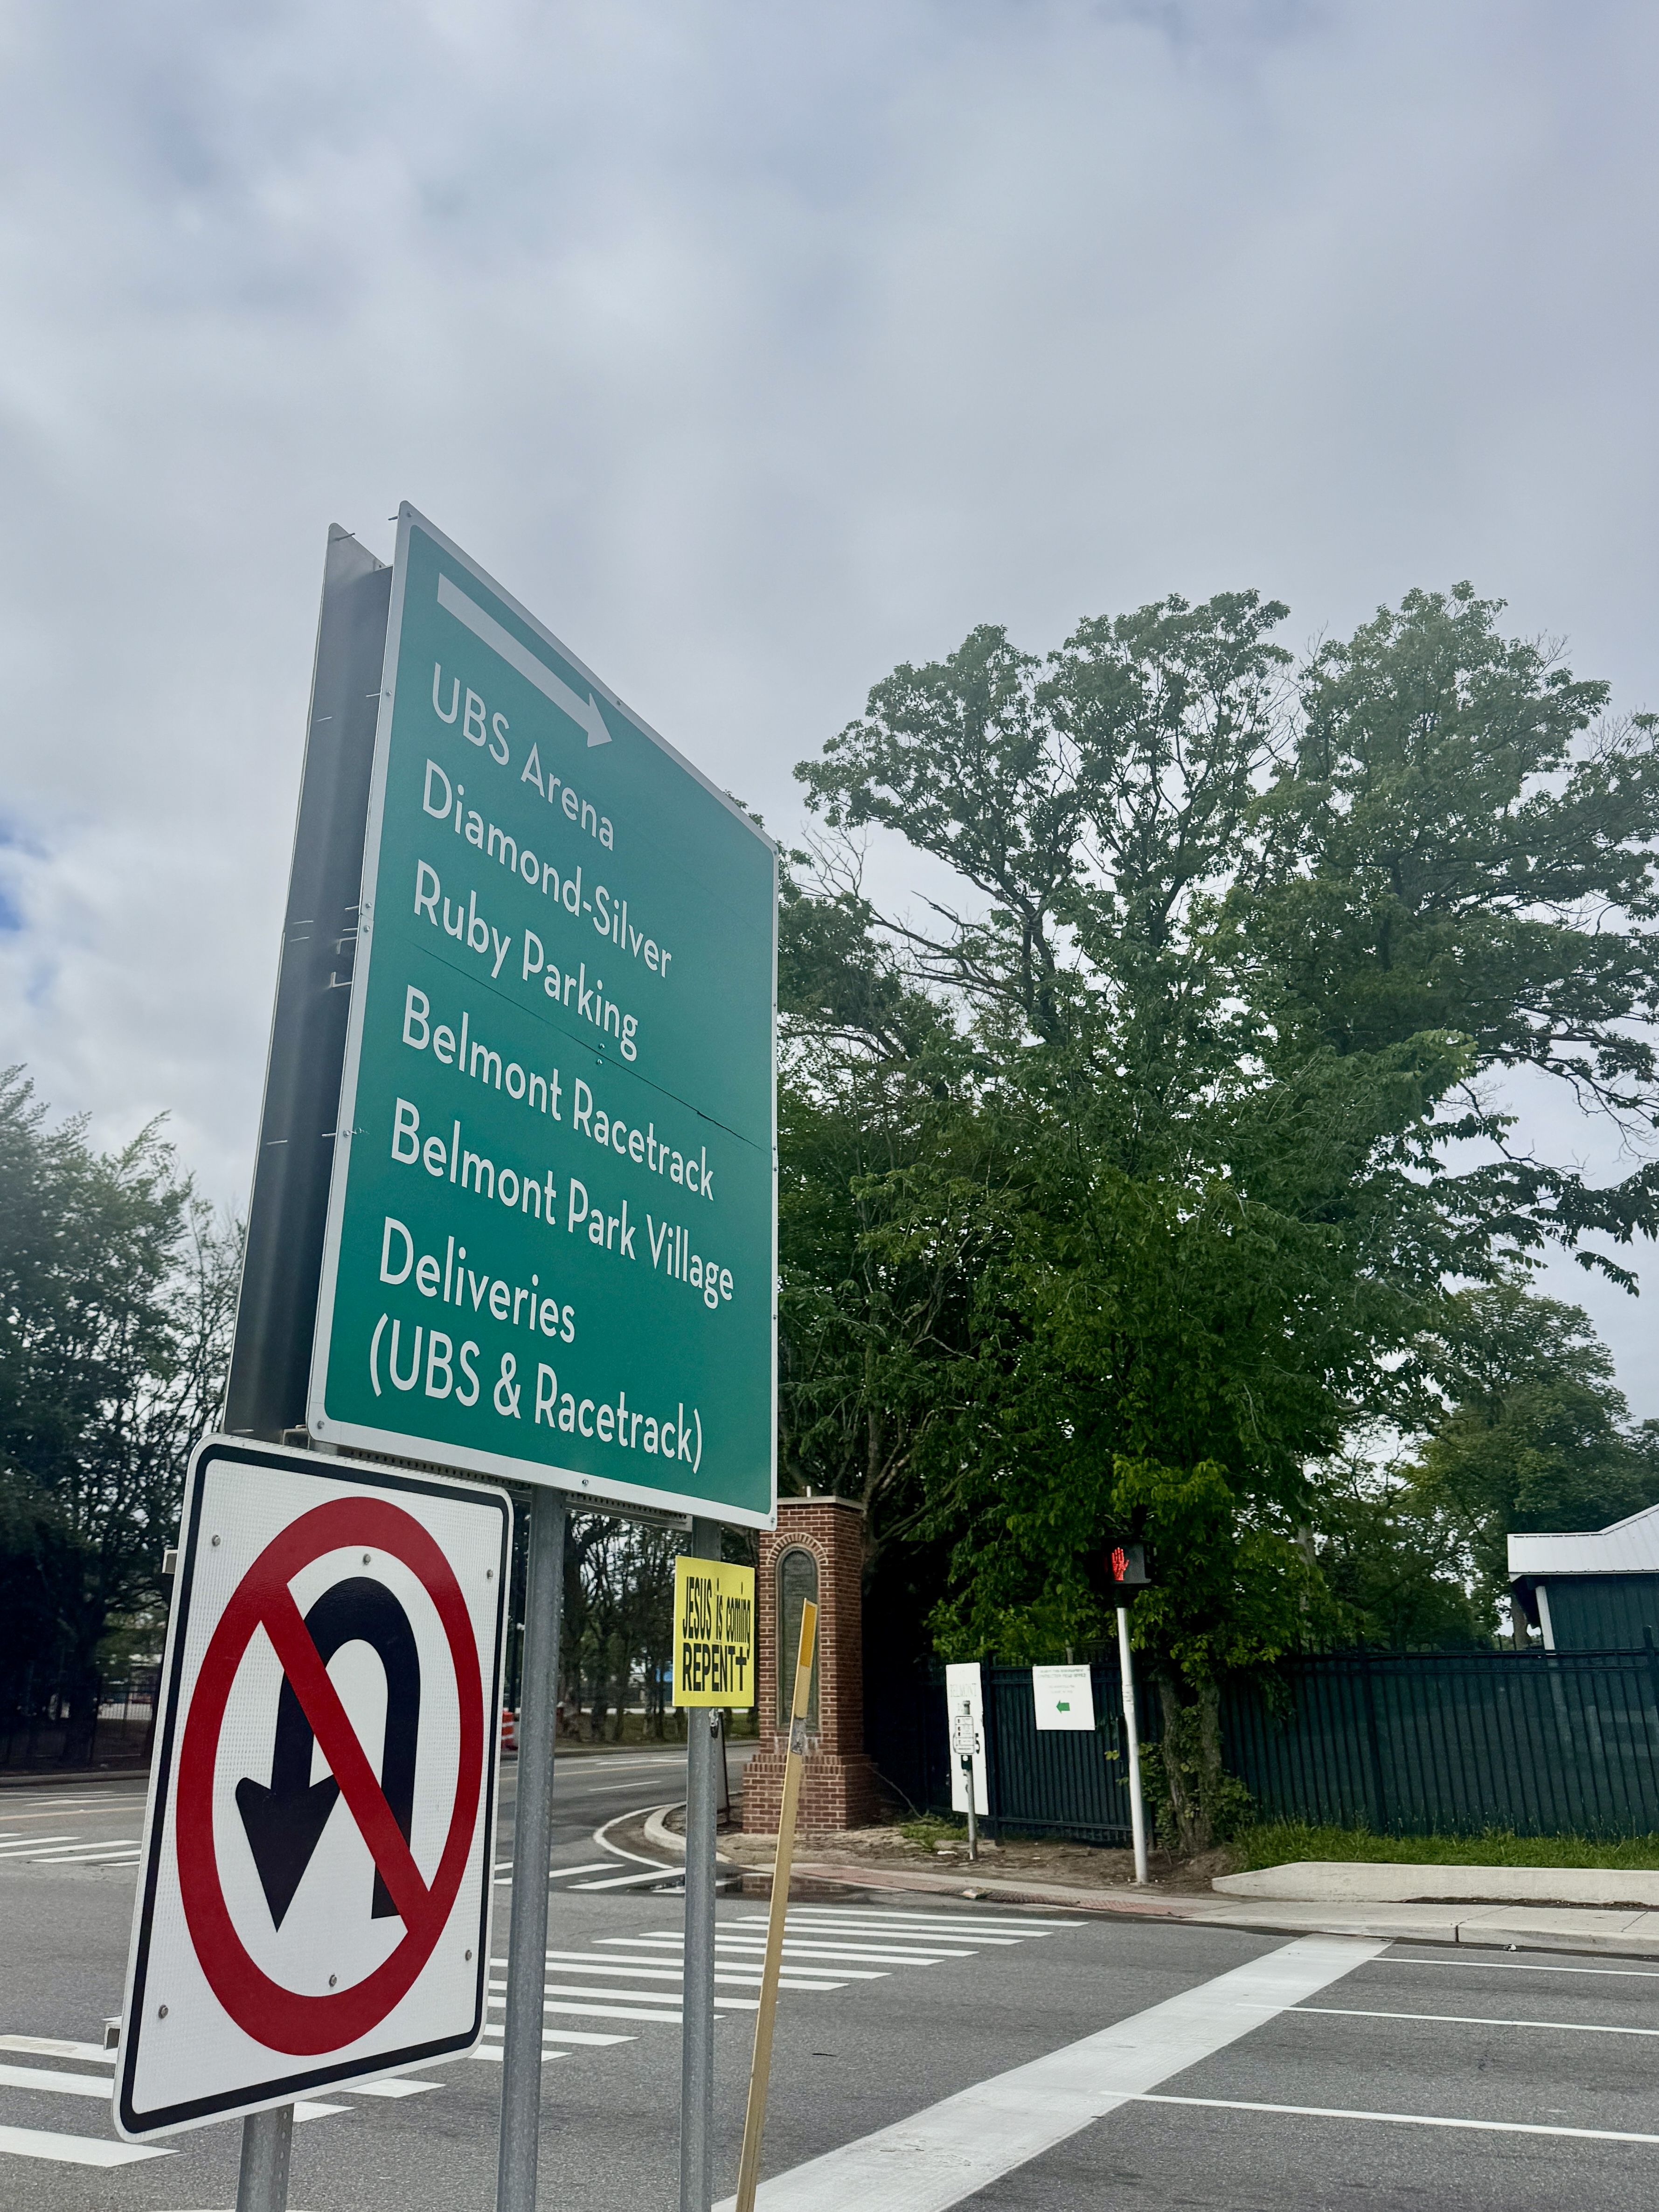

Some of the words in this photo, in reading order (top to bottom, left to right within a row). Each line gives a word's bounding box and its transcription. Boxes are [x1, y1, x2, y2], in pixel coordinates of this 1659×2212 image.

[432, 663, 509, 765] UBS
[521, 743, 614, 851] Arena
[414, 860, 511, 979] Ruby
[522, 930, 639, 1062] Parking
[423, 759, 672, 978] Diamond-Silver
[403, 985, 562, 1120] Belmont
[574, 1078, 714, 1201] Racetrack
[380, 1217, 575, 1343] Deliveries
[391, 1097, 556, 1224] Belmont
[568, 1178, 635, 1259] Park
[646, 1214, 734, 1309] Village
[370, 1313, 480, 1406] (UBS
[493, 1352, 521, 1419] &
[535, 1363, 701, 1474] Racetrack)
[682, 1576, 712, 1641] JESUS
[716, 1577, 723, 1641] is
[726, 1581, 751, 1660] coming
[682, 1642, 736, 1692] REPENT
